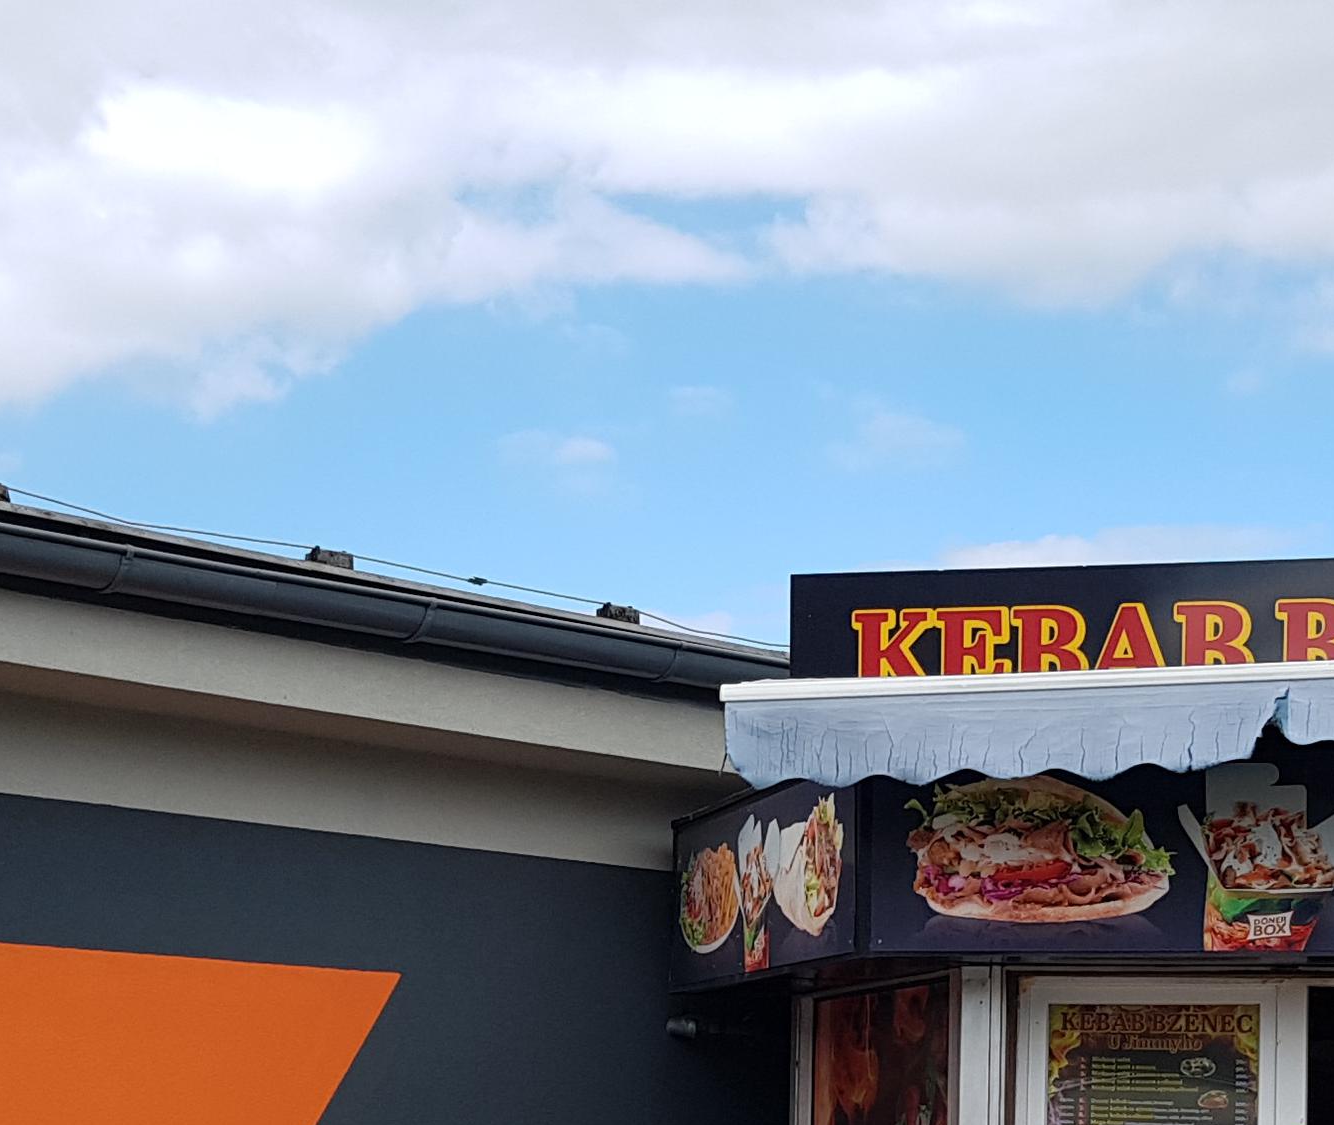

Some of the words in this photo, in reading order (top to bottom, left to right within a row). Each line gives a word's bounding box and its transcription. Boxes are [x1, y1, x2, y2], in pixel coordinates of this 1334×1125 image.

[851, 601, 1257, 678] KEBAB
[1253, 922, 1287, 936] BOX
[1060, 1011, 1146, 1033] KEBAB
[1152, 1013, 1253, 1034] BZENEC
